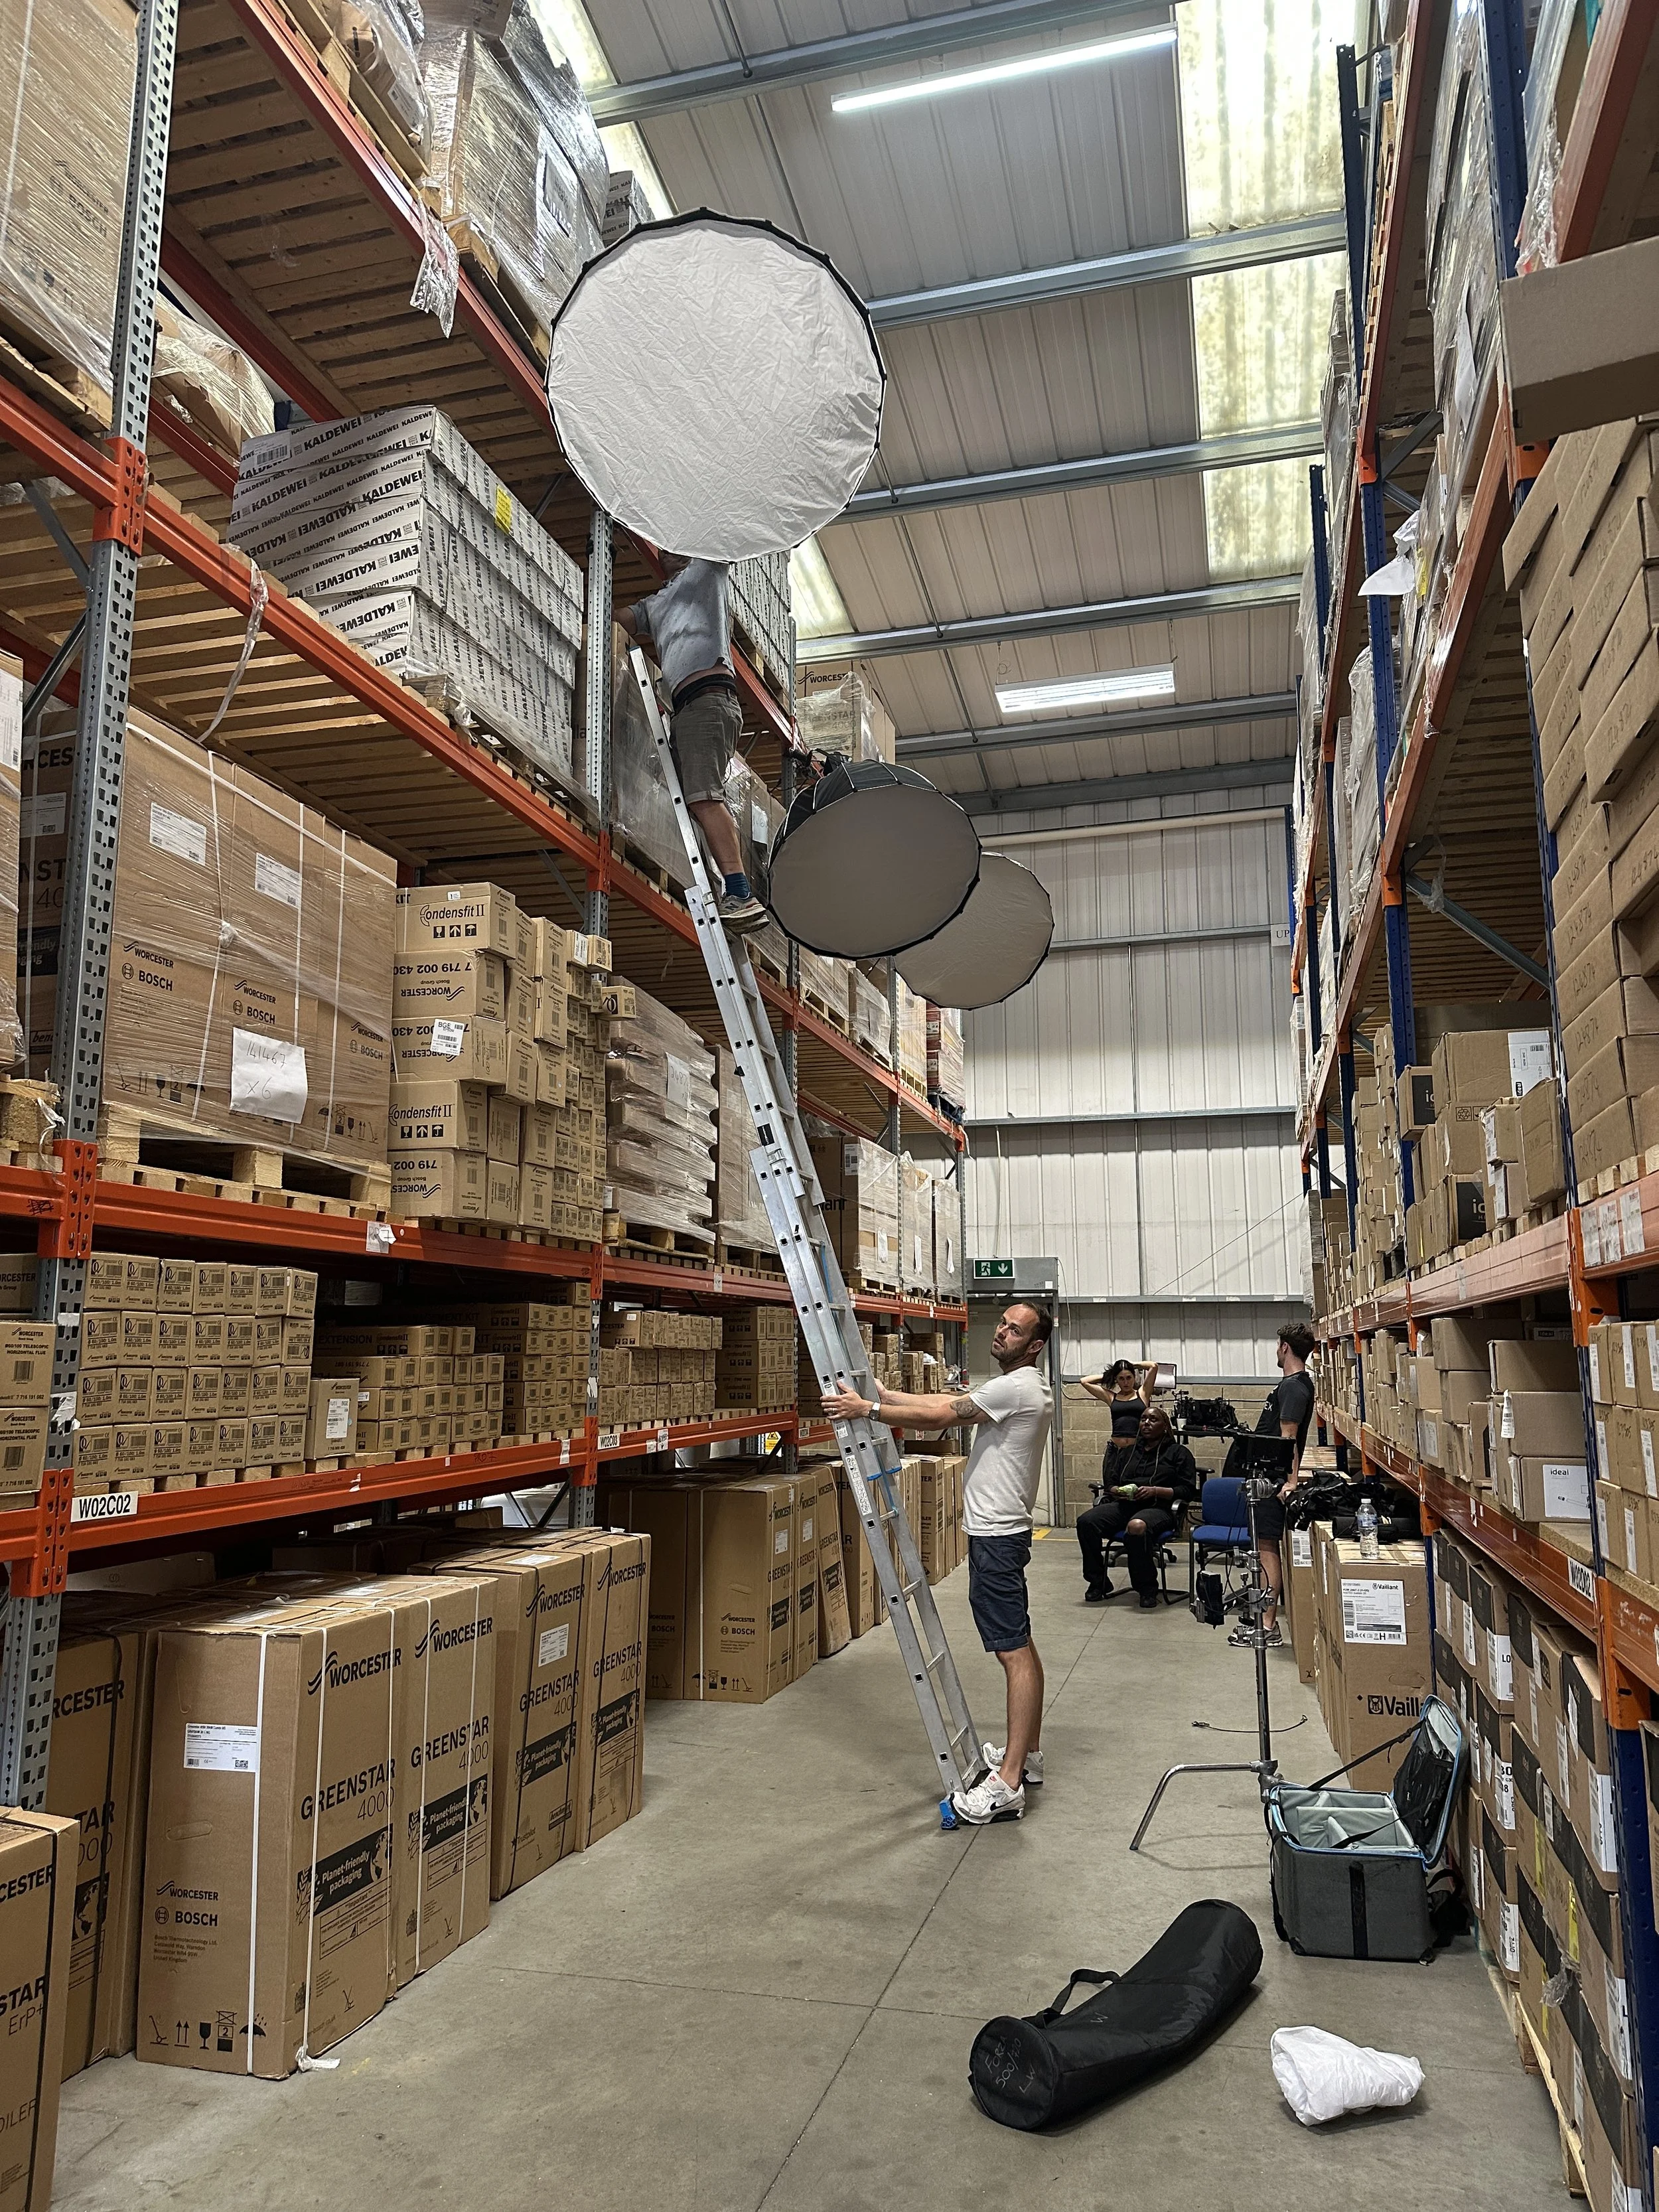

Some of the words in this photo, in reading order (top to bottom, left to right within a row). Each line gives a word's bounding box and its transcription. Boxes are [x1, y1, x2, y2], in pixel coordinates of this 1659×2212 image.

[304, 417, 362, 451] KALDEWEI
[332, 439, 364, 457] KALDEWEI
[366, 424, 399, 441] KALDEWEI
[241, 478, 271, 495] KALDEWEI
[313, 485, 344, 502] KALDEWEI
[347, 469, 378, 487] KALDEWEI
[381, 454, 413, 471] KALDEWEI
[362, 471, 422, 503] KALDEWEI
[252, 479, 307, 512] KALDEWEI
[298, 504, 356, 536] KALDEWEI
[372, 506, 404, 524] KALDEWEI
[228, 526, 259, 542] KALDEWEI
[338, 520, 369, 538] KALDEWEI
[304, 535, 334, 552] KALDEWEI
[313, 552, 345, 569] KALDEWEI
[316, 561, 376, 592] KALDEWEI
[420, 905, 474, 926] Condensfit
[135, 948, 174, 968] WORCESTER
[442, 963, 461, 972] 719
[465, 962, 471, 971] 7
[417, 964, 438, 974] 002
[139, 970, 173, 991] BOSCH
[244, 986, 276, 1003] WORCESTER
[401, 987, 451, 996] WORCESTER
[247, 1006, 275, 1025] BOSCH
[358, 1028, 384, 1043] WORCESTER
[392, 1027, 412, 1036] 430
[247, 1041, 287, 1068] 141467
[361, 1046, 383, 1061] BOSCH
[389, 1104, 441, 1126] Condensfit
[394, 1161, 415, 1170] 002
[419, 1160, 437, 1169] 719
[318, 1335, 372, 1344] EXTENSION
[600, 1435, 618, 1447] W02C03
[80, 1494, 131, 1518] W02C02
[607, 1562, 646, 1588] WORCESTER
[540, 1584, 585, 1613] WORCESTER
[433, 1617, 492, 1652] WORCESTER
[330, 1648, 401, 1688] WORCESTER
[594, 1641, 642, 1678] GREENSTAR
[621, 1661, 642, 1683] 4000
[520, 1670, 579, 1712] GREENSTAR
[554, 1692, 579, 1716] 4000
[531, 1740, 561, 1761] Planet-friendly
[535, 1752, 556, 1771] packaging
[301, 1758, 396, 1820] GREENSTAR
[357, 1786, 394, 1820] 4000
[436, 1811, 463, 1834] packaging
[322, 1850, 370, 1884] Planet-friendly
[330, 1868, 362, 1894] packaging
[170, 1888, 218, 1901] WORCESTER
[175, 1911, 218, 1927] BOSCH
[985, 2035, 1007, 2074] FORZA
